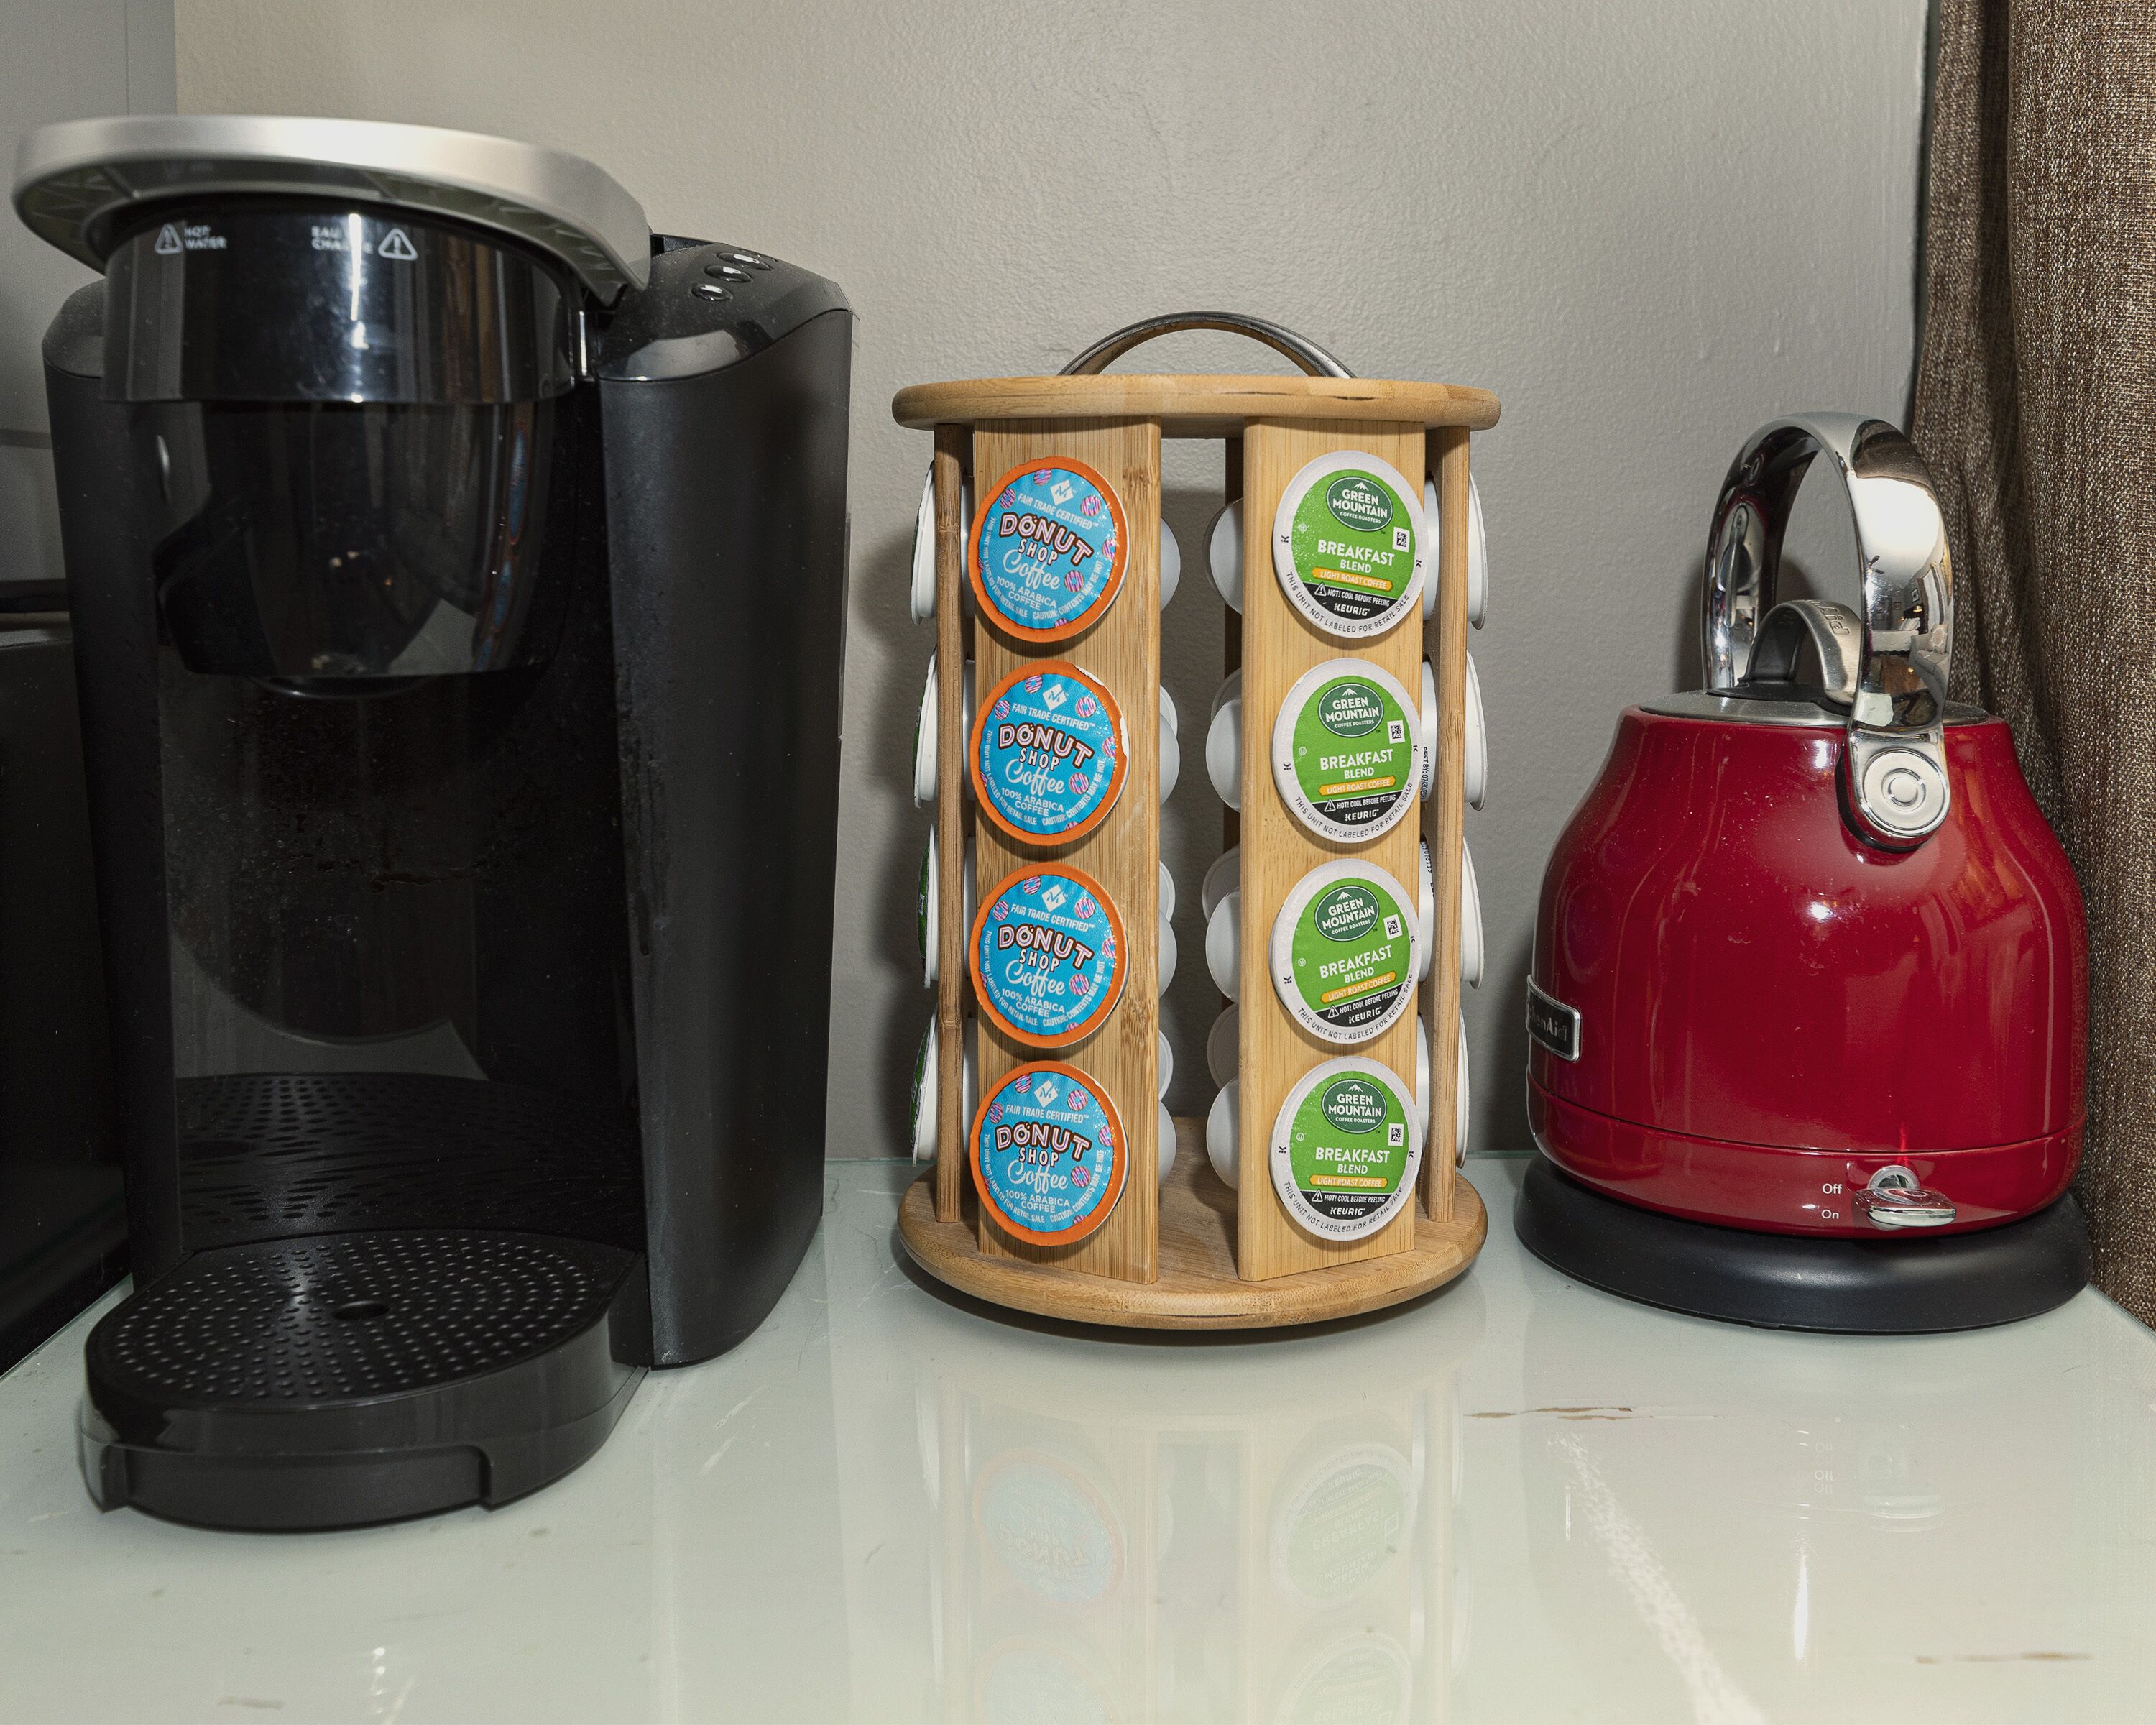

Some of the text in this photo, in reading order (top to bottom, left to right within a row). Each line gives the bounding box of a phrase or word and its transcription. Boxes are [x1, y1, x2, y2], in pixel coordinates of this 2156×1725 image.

[1018, 494, 1032, 504] FAIR
[1033, 501, 1054, 515] TRADE
[1342, 489, 1378, 505] GREEN
[1333, 498, 1387, 518] MOUNTAIN
[1340, 511, 1381, 524] COFFEE ROASTERS
[1000, 513, 1093, 565] DONUT
[1019, 539, 1058, 565] SHOP
[1318, 540, 1394, 566] BREAKFAST
[1003, 550, 1060, 589] Coffee
[1340, 560, 1371, 573] BLEND
[1321, 570, 1387, 589] LIGHT ROAST COFFEE
[997, 576, 1015, 591] 100%
[1018, 585, 1056, 608] ARABICA
[1008, 592, 1041, 610] COFFEE
[1286, 572, 1296, 591] THIS
[1296, 593, 1309, 610] UNIT
[1312, 609, 1324, 622] NOT
[1325, 619, 1355, 632] LABELED
[1374, 612, 1396, 628] RETAIL
[1396, 594, 1409, 612] SALE
[1334, 603, 1368, 616] KEURIG
[1012, 704, 1026, 714] FAIR
[1028, 707, 1050, 720] TRADE
[1332, 697, 1368, 709] GREEN
[1325, 707, 1379, 722] MOUNTAIN
[998, 723, 1094, 768] DONUT
[1019, 748, 1059, 770] SHOP
[1320, 749, 1393, 770] BREAKFAST
[1007, 759, 1064, 796] Coffee
[1344, 768, 1374, 778] BLEND
[1327, 779, 1390, 794] LIGHT ROAST COFFEE
[1002, 788, 1021, 800] 100%
[1024, 795, 1063, 812] ARABICA
[1015, 800, 1049, 816] COFFEE
[1295, 796, 1307, 814] THIS
[1308, 814, 1322, 827] UNIT
[1323, 825, 1337, 836] NOT
[1340, 829, 1368, 838] LABELED
[1370, 822, 1383, 833] FOR
[1386, 804, 1403, 824] RETAIL
[1401, 783, 1412, 801] SALE
[1345, 810, 1377, 821] KEURIG
[1011, 903, 1026, 914] FAIR
[1028, 908, 1050, 922] TRADE
[1328, 898, 1364, 916] GREEN
[1322, 906, 1375, 930] MOUNTAIN
[1332, 920, 1370, 934] COFFEE ROASTERS
[998, 924, 1094, 970] DONUT
[1019, 949, 1059, 972] SHOP
[1319, 945, 1391, 979] BREAKFAST
[1006, 960, 1065, 998] Coffee
[1345, 967, 1374, 983] BLEND
[1329, 975, 1391, 1001] LIGHT ROAST COFFEE
[1002, 989, 1022, 1001] 100%
[1025, 995, 1064, 1013] ARABICA
[1015, 1001, 1049, 1017] COFFEE
[1298, 1008, 1310, 1023] THIS
[1312, 1022, 1327, 1034] UNIT
[1329, 1031, 1342, 1039] NOT
[1345, 1028, 1373, 1039] LABELED
[1376, 1018, 1388, 1030] FOR
[1389, 996, 1405, 1019] RETAIL
[1349, 1009, 1380, 1024] KEURIG
[1337, 1094, 1373, 1104] GREEN
[1023, 1107, 1044, 1118] TRADE
[1328, 1105, 1381, 1117] MOUNTAIN
[995, 1122, 1092, 1162] DONUT
[1019, 1147, 1059, 1167] SHOP
[1315, 1147, 1390, 1163] BREAKFAST
[1008, 1160, 1068, 1194] Coffee
[1337, 1164, 1368, 1174] BLEND
[1006, 1190, 1070, 1207] 100% ARABICA
[1822, 1184, 1843, 1195] Off
[1021, 1202, 1055, 1212] COFFEE
[1284, 1181, 1294, 1199] THIS
[1293, 1201, 1306, 1216] UNIT
[1307, 1215, 1319, 1228] NOT
[1321, 1220, 1351, 1232] LABELED
[1353, 1221, 1366, 1230] FOR
[1368, 1207, 1389, 1225] RETAIL
[1821, 1209, 1840, 1220] On
